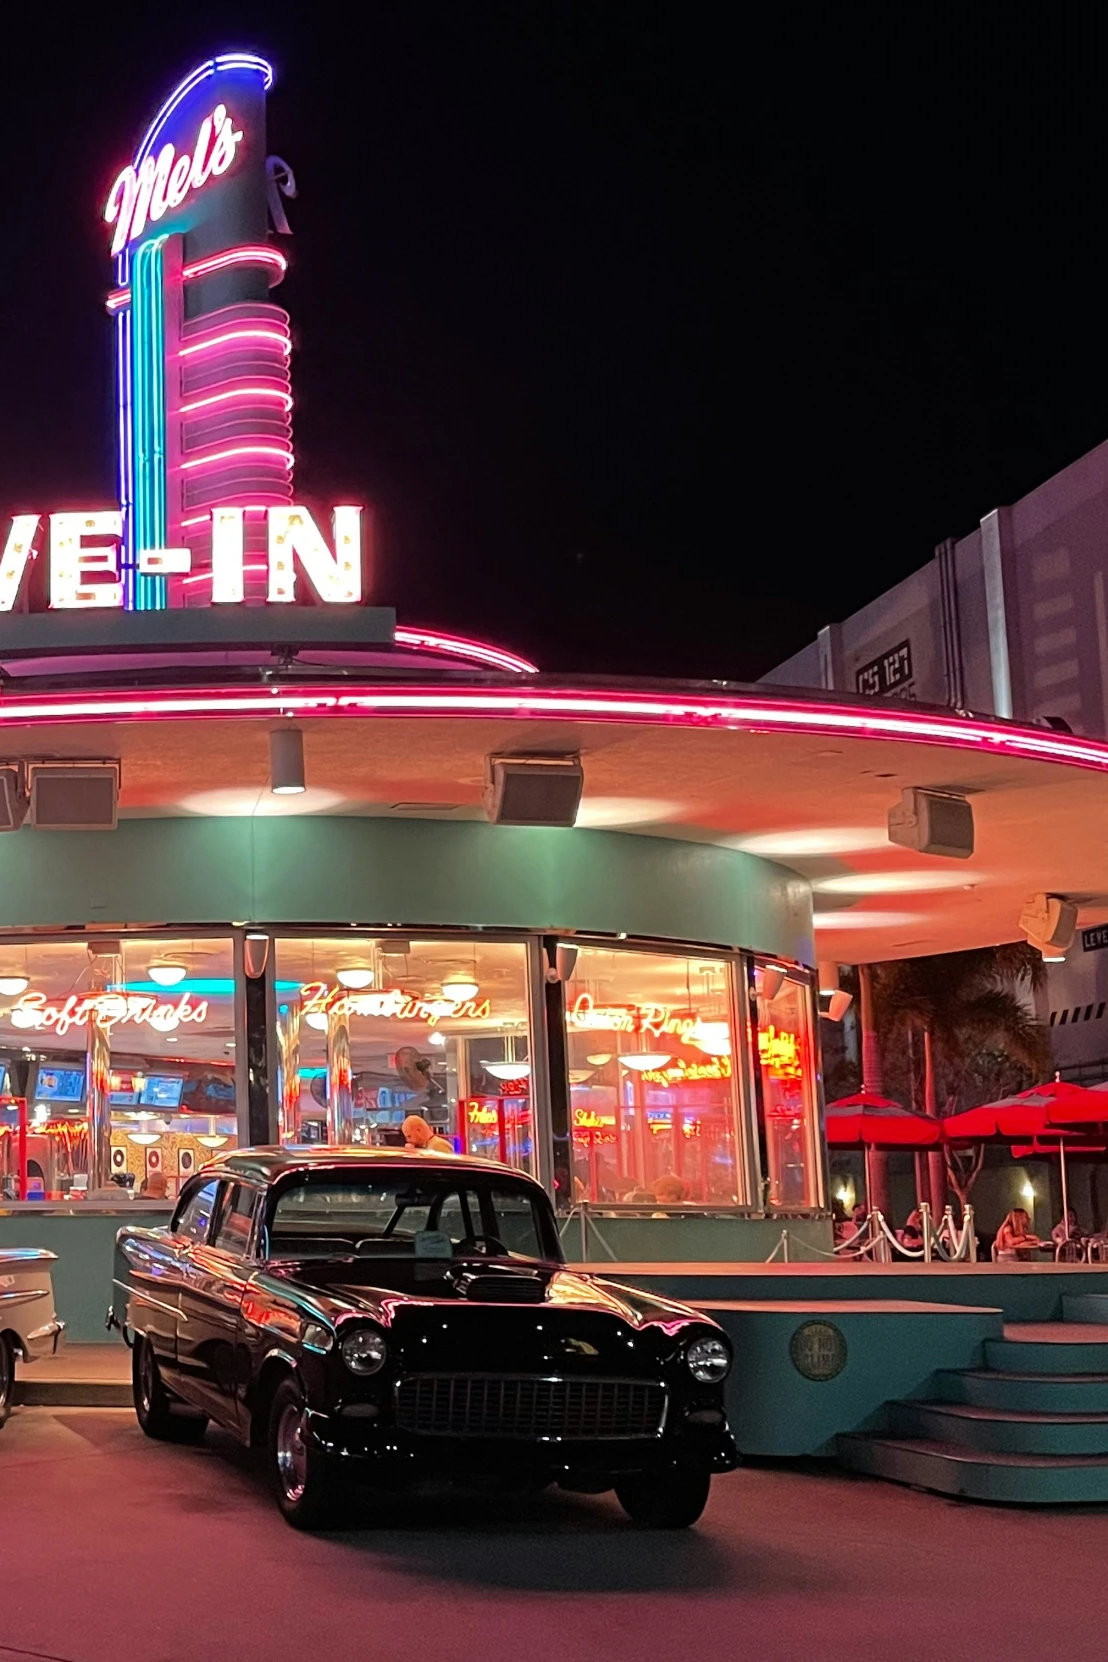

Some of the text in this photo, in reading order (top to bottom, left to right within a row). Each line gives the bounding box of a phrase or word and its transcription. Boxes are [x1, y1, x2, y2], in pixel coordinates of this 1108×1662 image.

[103, 104, 243, 257] Mel's
[884, 647, 908, 686] 127
[10, 992, 209, 1036] Soft Drinks
